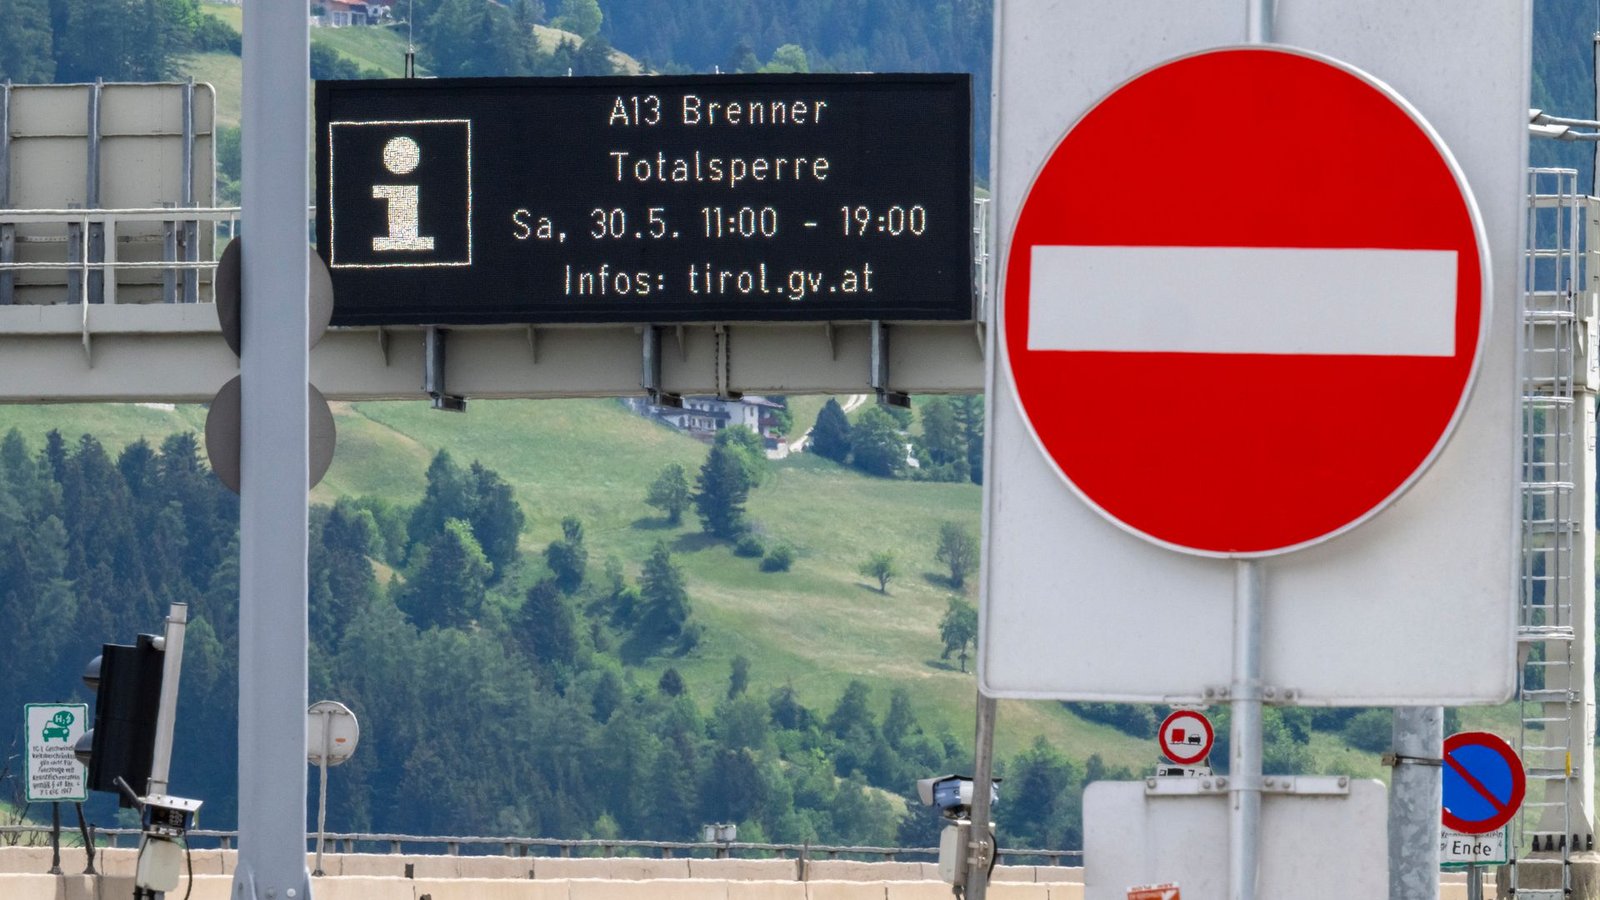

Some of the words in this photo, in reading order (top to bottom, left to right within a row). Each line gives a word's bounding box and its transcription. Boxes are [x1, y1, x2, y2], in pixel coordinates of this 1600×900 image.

[609, 95, 661, 126] A13
[682, 94, 828, 125] Brenner
[609, 151, 830, 188] Totalsperre
[512, 208, 567, 243] Sa,
[590, 207, 679, 240] 30.5.
[701, 206, 778, 238] 11:00
[840, 205, 926, 237] 19:00
[565, 264, 664, 296] Infos:
[688, 262, 873, 301] tirol.gv.at
[1452, 840, 1492, 856] Ende
